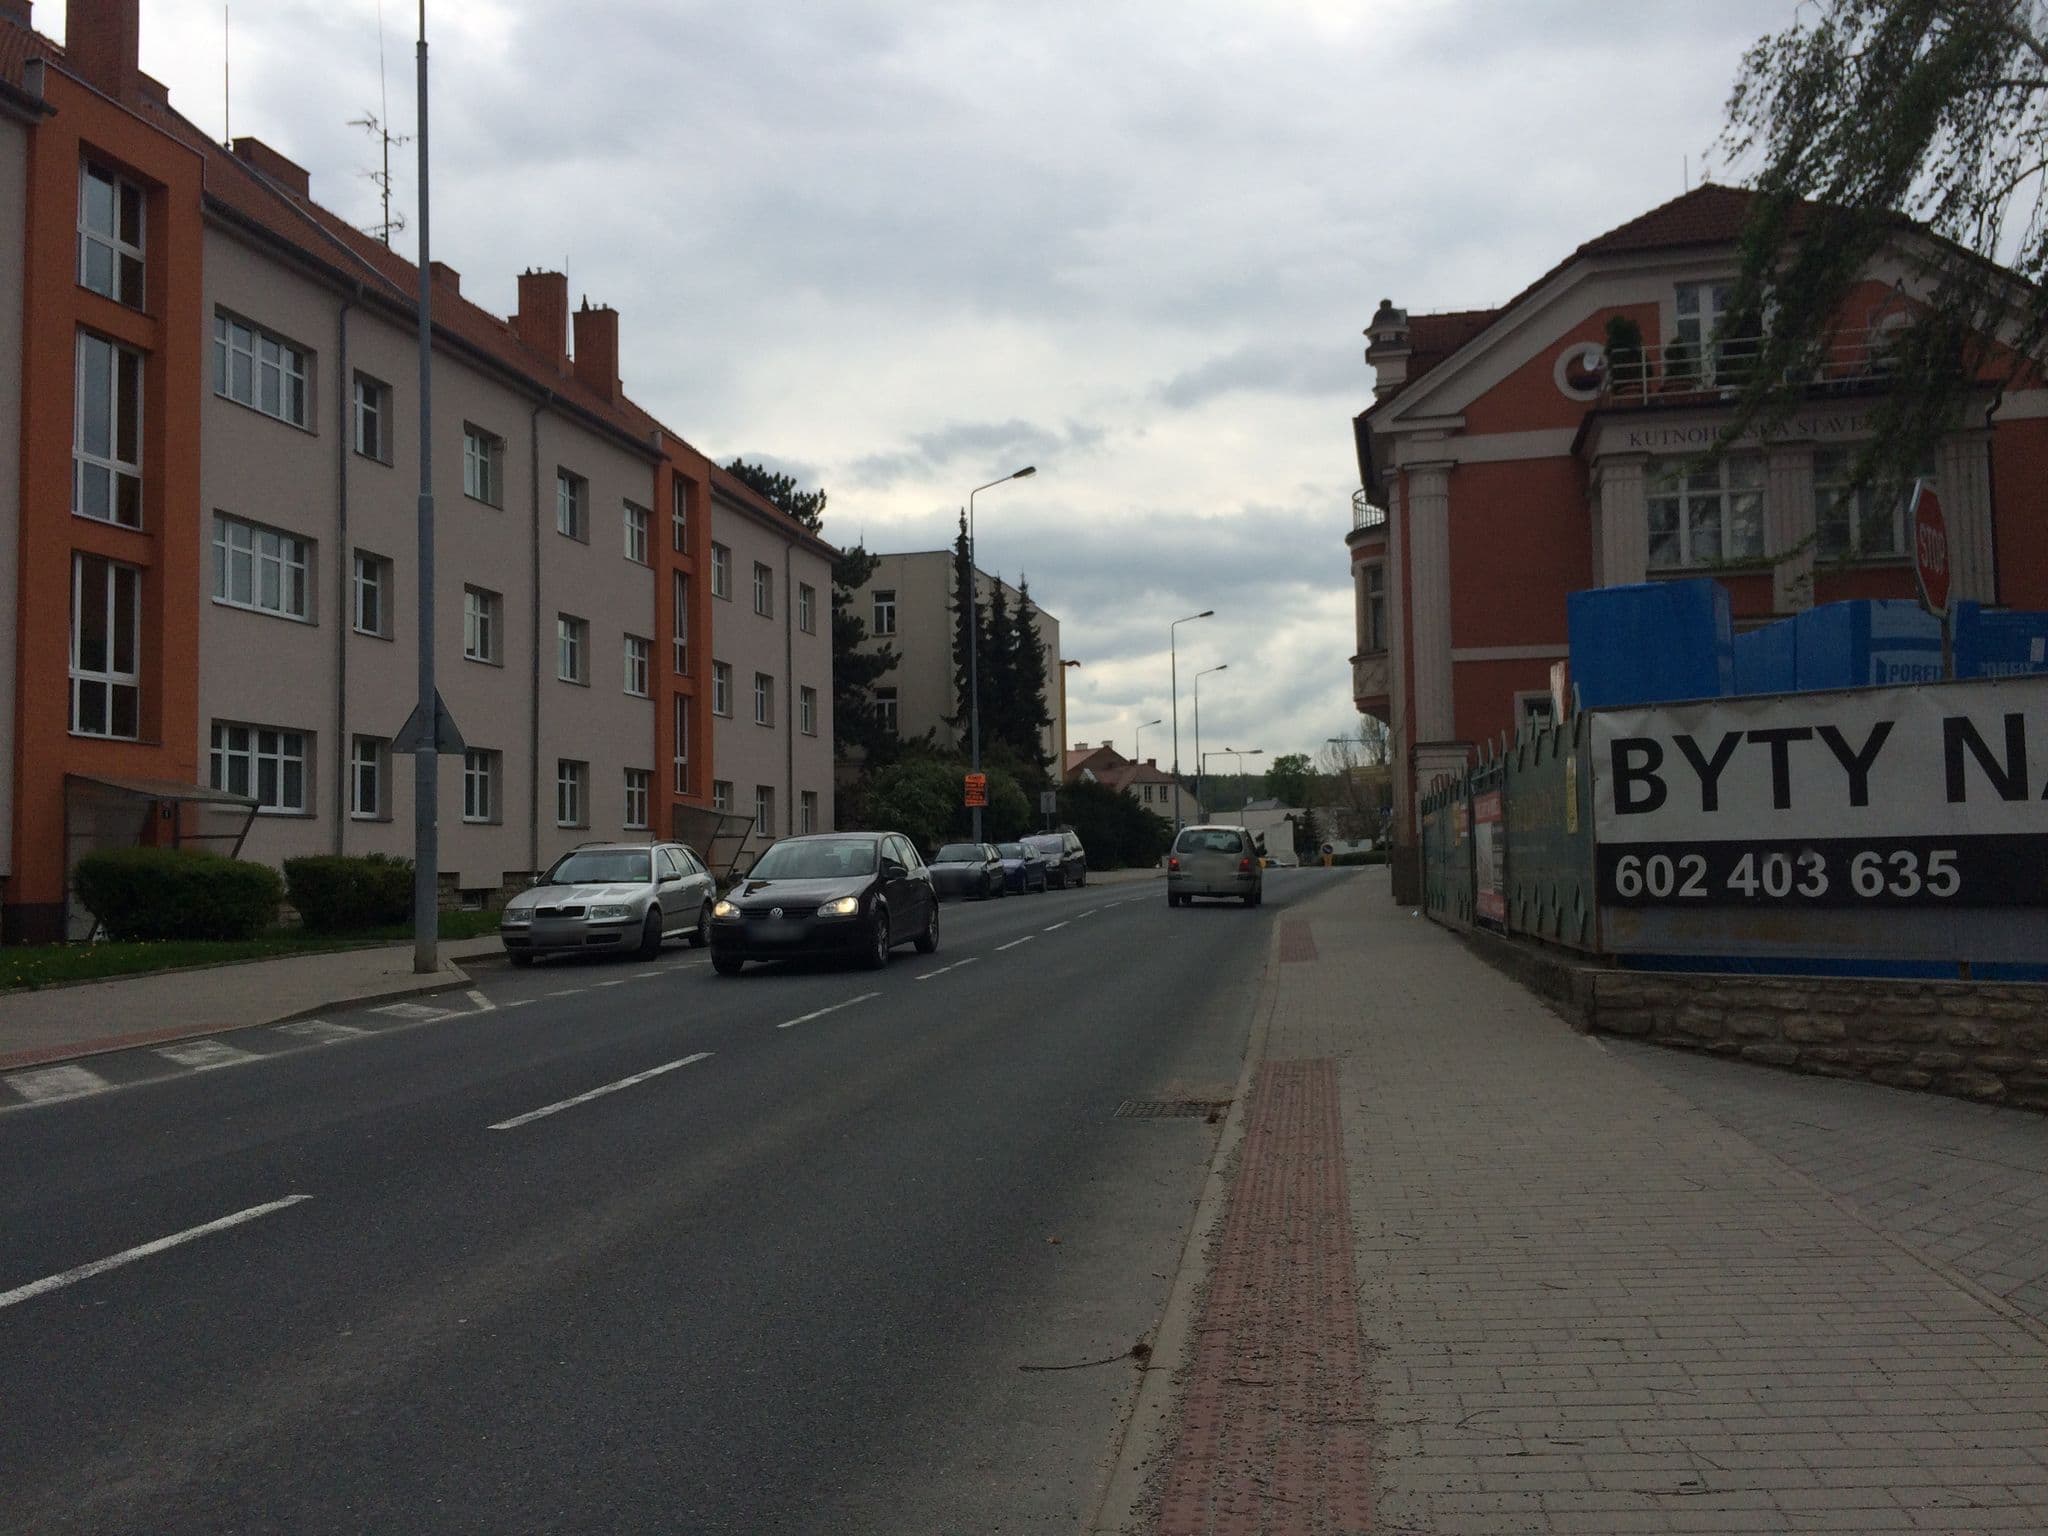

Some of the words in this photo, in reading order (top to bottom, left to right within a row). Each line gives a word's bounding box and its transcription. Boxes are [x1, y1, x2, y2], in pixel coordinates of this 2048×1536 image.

[1919, 522, 1945, 575] STOP
[1610, 720, 1896, 815] BYTY
[1942, 711, 2048, 804] N
[1615, 853, 1708, 897] 602
[1727, 851, 1830, 897] 403
[1850, 850, 1961, 897] 635
